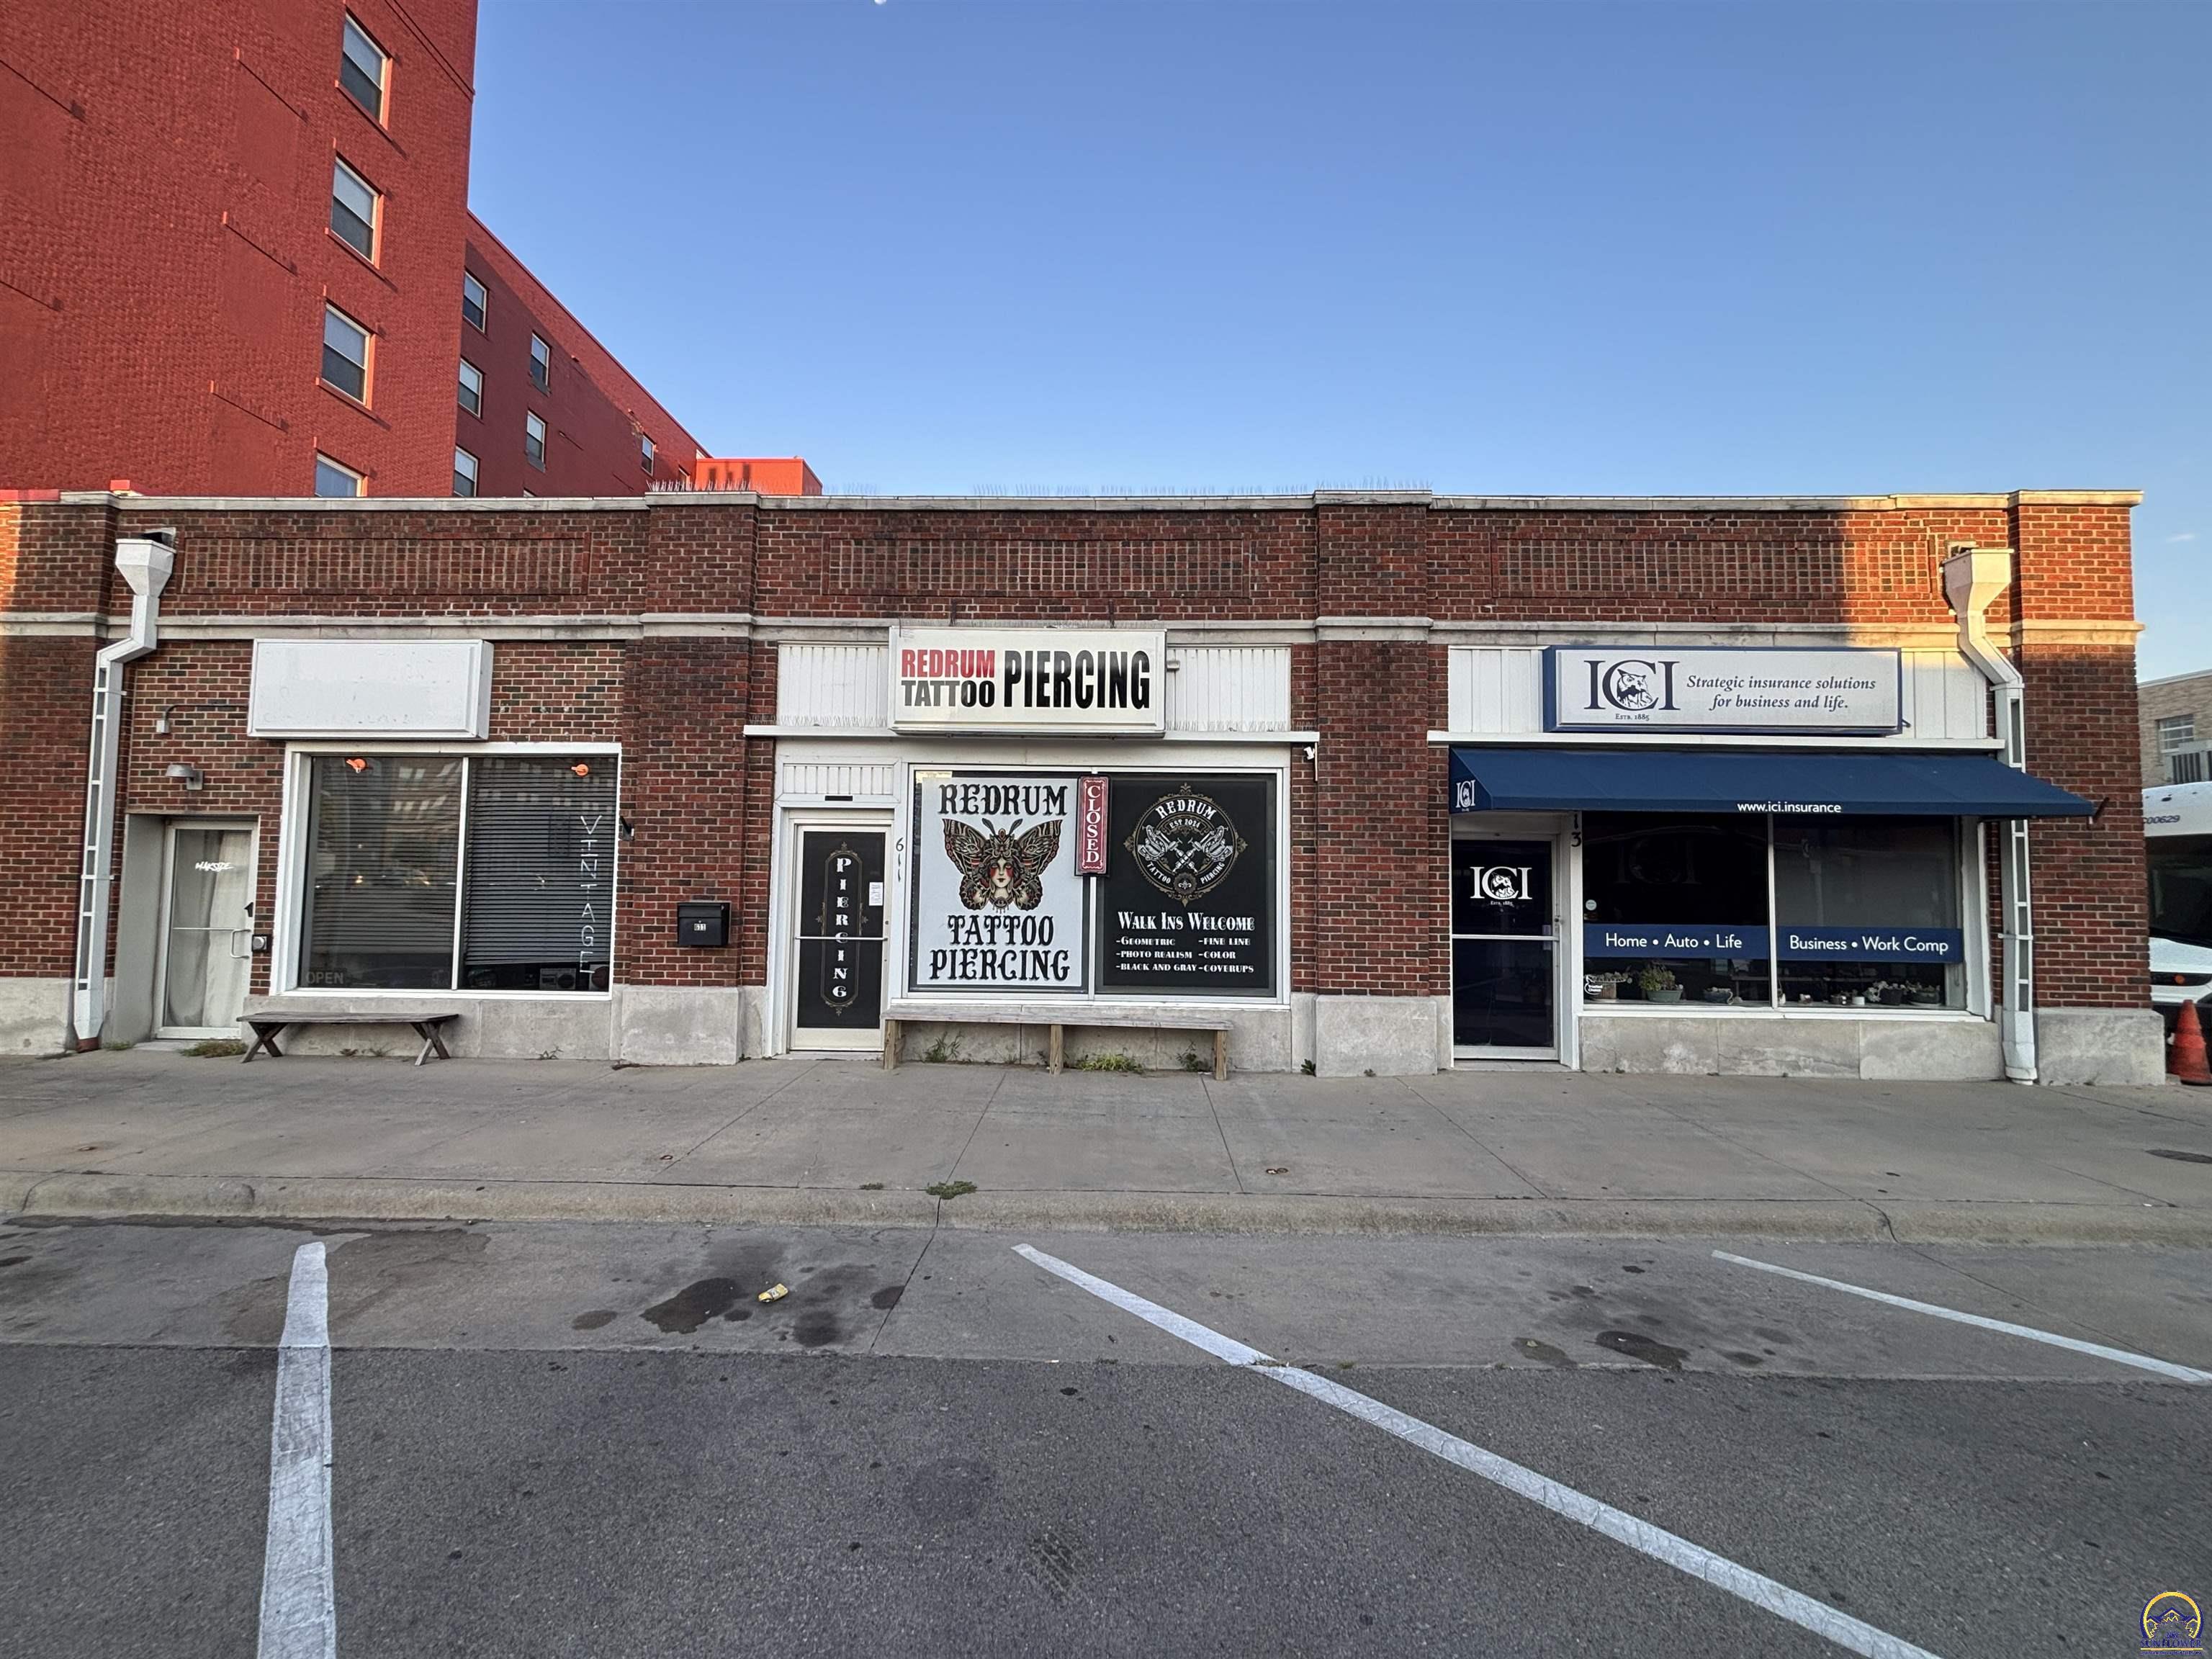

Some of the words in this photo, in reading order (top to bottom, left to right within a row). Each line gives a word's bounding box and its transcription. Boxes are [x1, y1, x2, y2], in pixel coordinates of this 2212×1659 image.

[902, 649, 995, 678] REDRUM
[1004, 650, 1150, 709] PIERCING
[1583, 660, 1681, 711] ICI
[1686, 675, 1745, 692] Strategic
[1748, 676, 1812, 689] insurance
[1815, 676, 1876, 689] solutions
[902, 680, 995, 707] TATTOO
[1709, 694, 1732, 711] for
[1736, 695, 1790, 708] business
[1794, 696, 1819, 708] and
[1823, 696, 1848, 711] life.
[938, 783, 1068, 816] REDRUM
[1455, 780, 1476, 808] ICI
[1737, 801, 1842, 814] www.ici.insurance
[1155, 799, 1217, 820] REDRUM
[1086, 785, 1101, 863] CLOSED
[1169, 819, 1184, 829] EST
[1147, 862, 1172, 884] TATTOO
[1200, 862, 1225, 884] PIERCING
[1470, 866, 1532, 900] ICI
[580, 815, 603, 974] VINTAGE
[832, 858, 852, 997] PIERCING
[948, 914, 1054, 945] TATTOO
[1606, 932, 1647, 947] Home
[1664, 933, 1699, 948] Auto
[1716, 934, 1742, 948] Life
[1789, 935, 1847, 950] Business
[1862, 936, 1900, 950] Work
[1904, 937, 1948, 956] Comp
[305, 972, 343, 984] OPEN
[929, 948, 1070, 981] PIERCING
